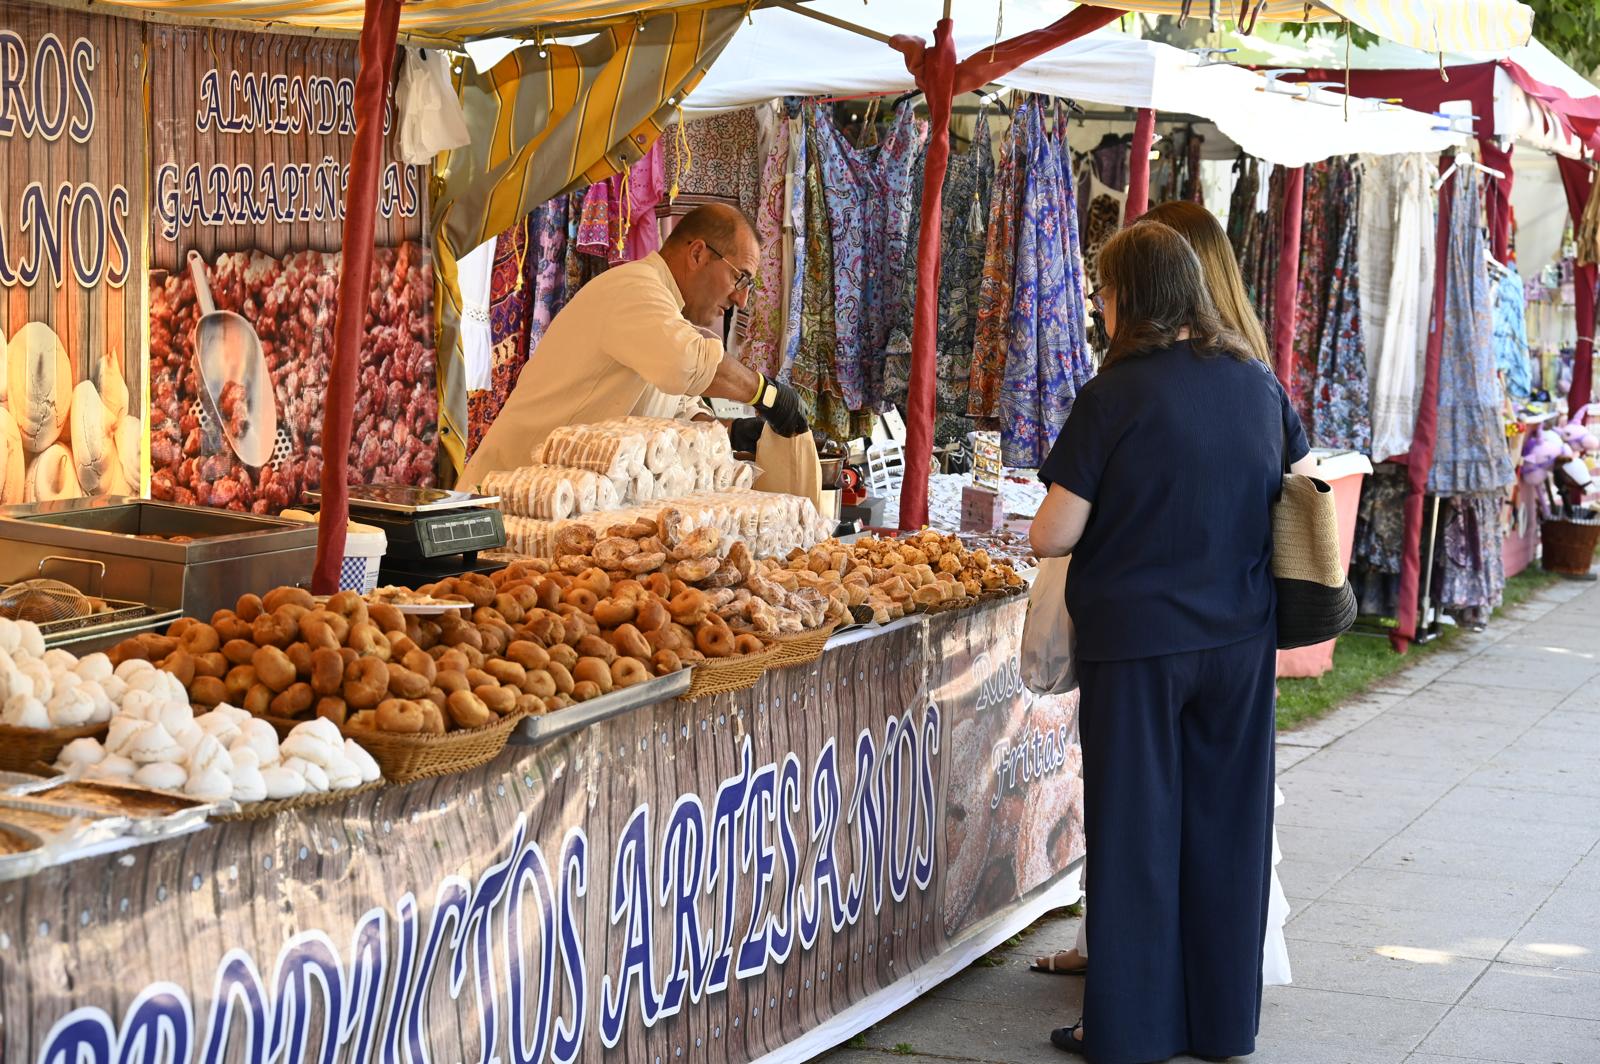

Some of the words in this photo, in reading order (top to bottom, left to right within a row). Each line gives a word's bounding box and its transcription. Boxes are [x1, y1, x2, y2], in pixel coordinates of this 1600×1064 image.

[196, 69, 391, 135] ALMENDR
[0, 181, 131, 288] NOS
[157, 156, 418, 241] GARRAPIÑAS
[991, 720, 1067, 809] Fritas
[599, 700, 940, 1049] ARTESANOS
